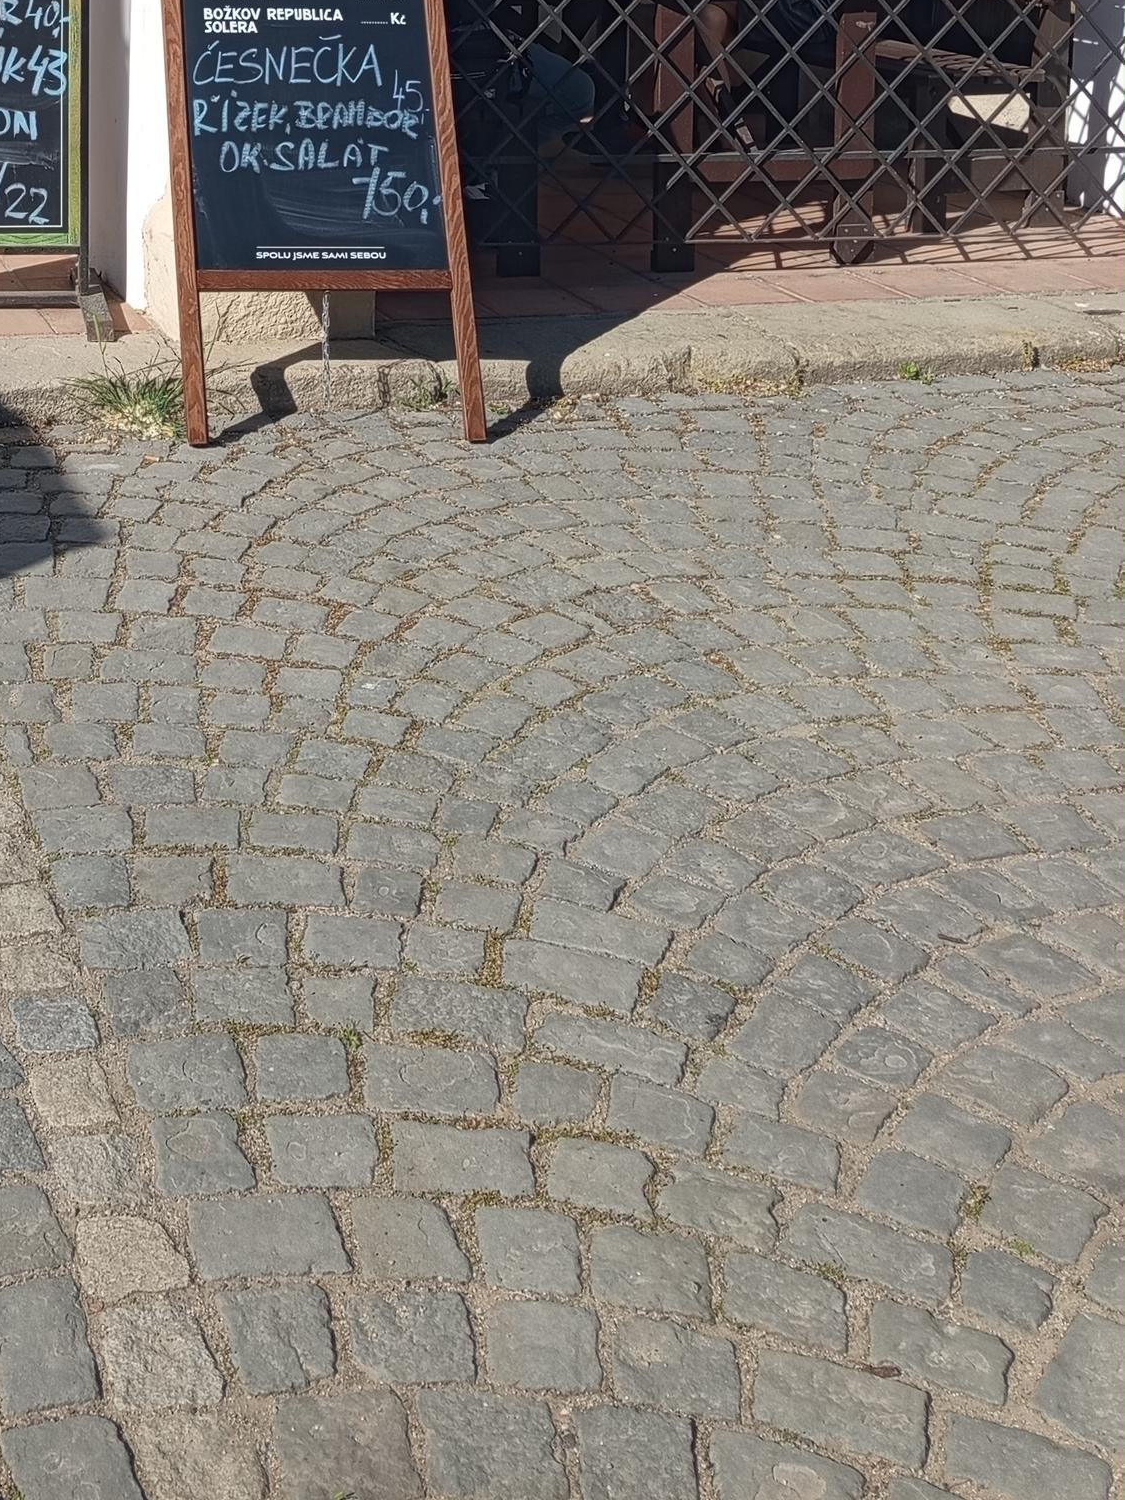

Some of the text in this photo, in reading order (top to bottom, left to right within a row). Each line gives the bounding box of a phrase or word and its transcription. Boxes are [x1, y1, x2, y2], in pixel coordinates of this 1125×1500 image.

[203, 5, 344, 22] BOŽKOV REPUBLICA
[390, 12, 407, 25] Kč
[204, 21, 259, 34] SOLERA
[256, 251, 387, 261] SPOLU JSME SAMI SEBOU
